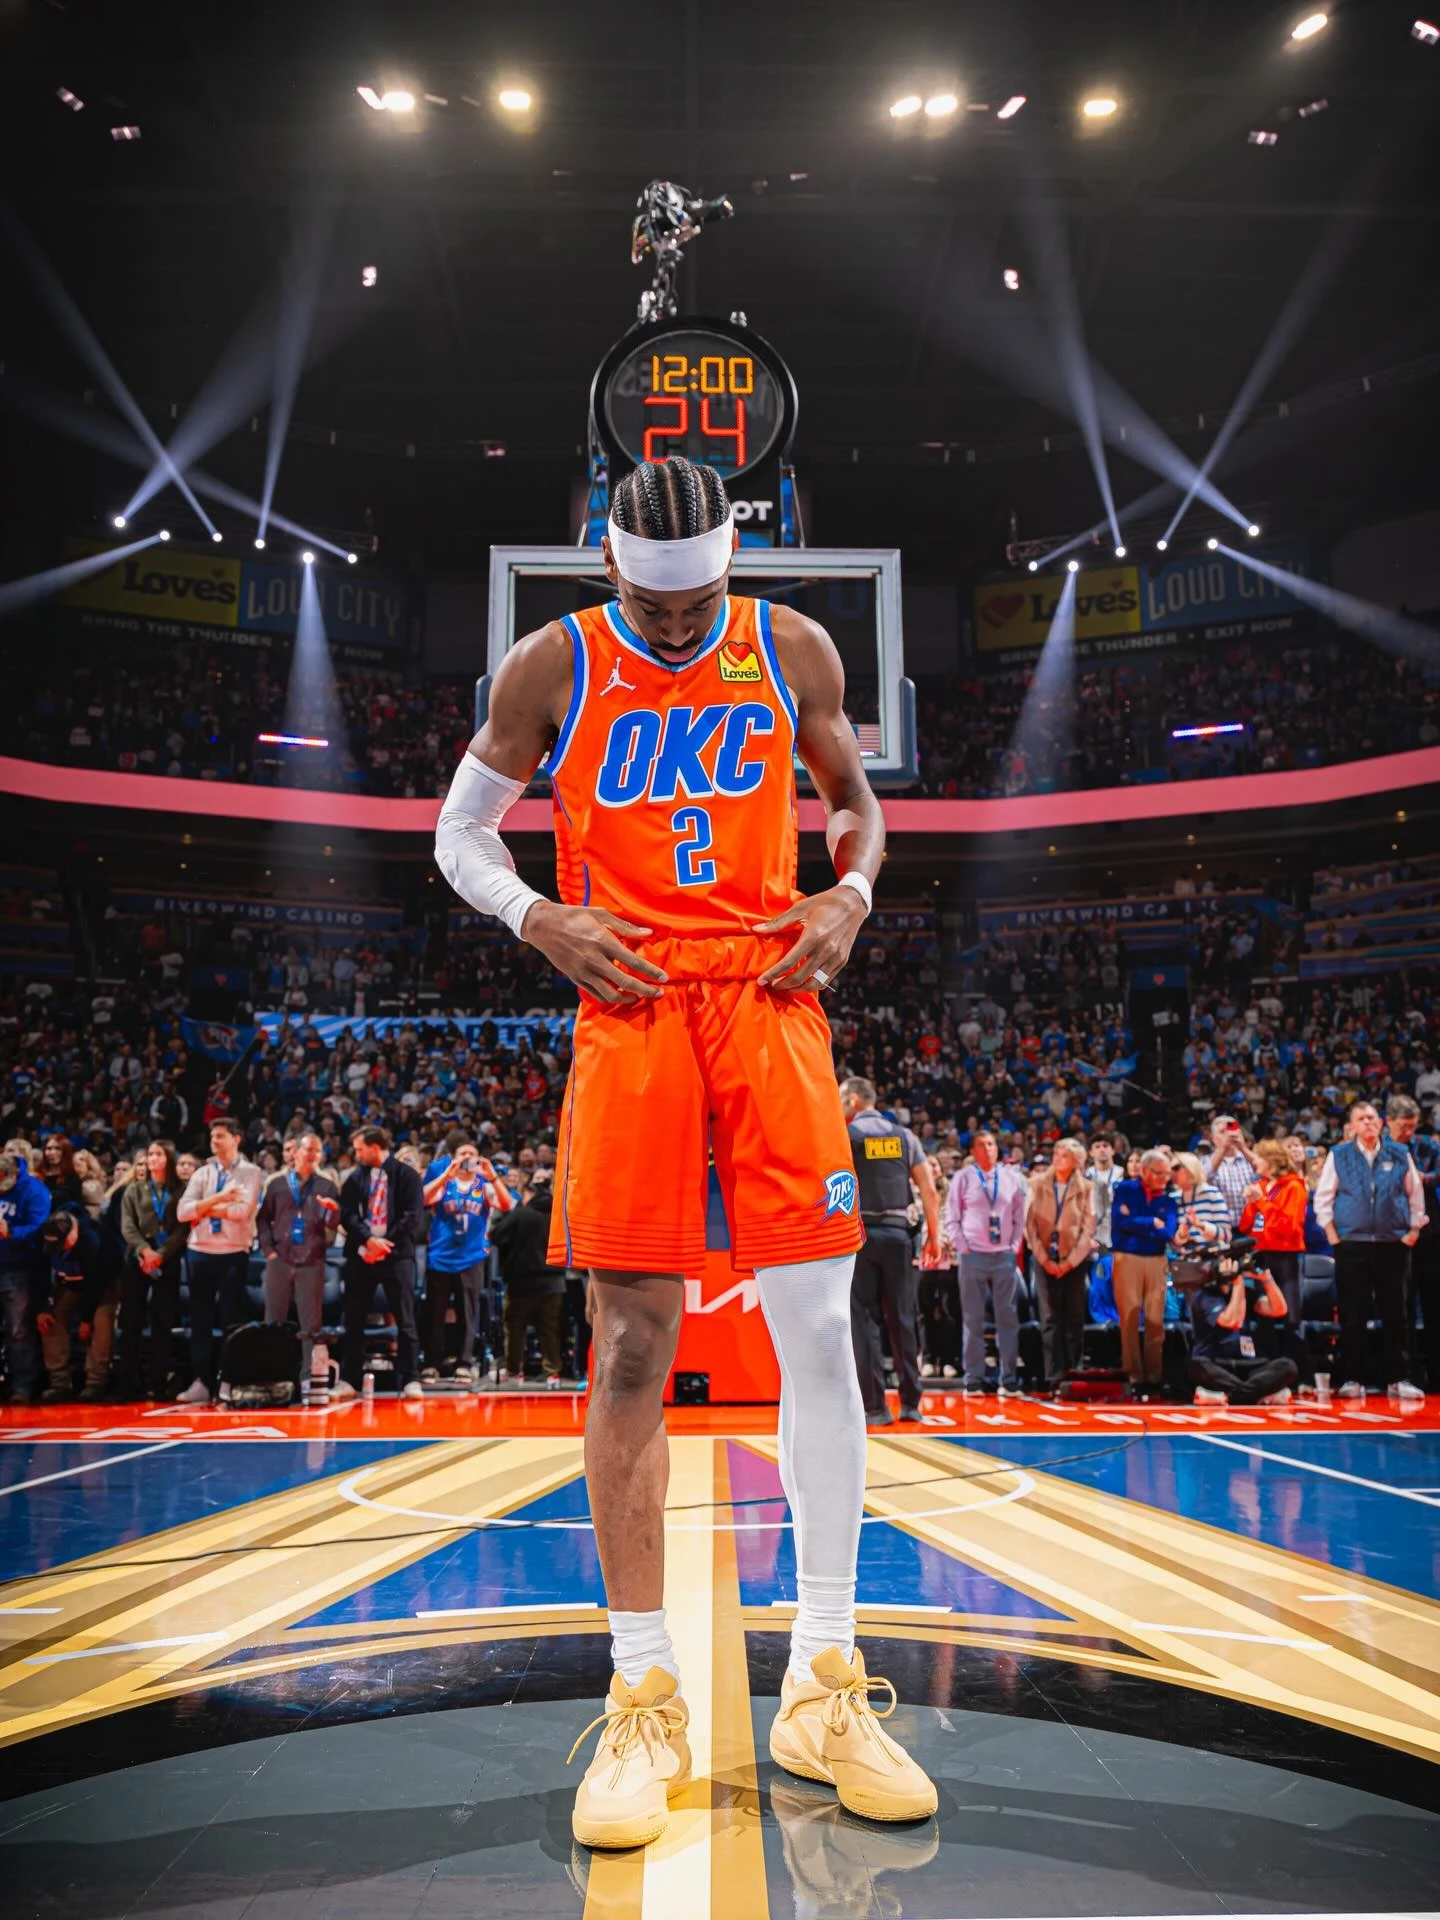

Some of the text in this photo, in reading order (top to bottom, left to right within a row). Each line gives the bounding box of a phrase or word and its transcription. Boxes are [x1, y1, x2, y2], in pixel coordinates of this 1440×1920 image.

[652, 355, 753, 394] 12:00
[643, 396, 746, 468] 24
[339, 583, 400, 637] CITY
[1148, 562, 1226, 621] LOUD
[146, 622, 182, 636] THE
[187, 626, 273, 647] THUNDER
[1095, 631, 1177, 652] THUNDER
[1204, 623, 1247, 640] EXIT
[1250, 616, 1293, 633] NOW
[595, 702, 775, 808] OKC
[671, 806, 717, 887] 2
[286, 908, 364, 925] CASINO
[868, 1139, 899, 1156] POLICE
[828, 1177, 851, 1210] OKC
[920, 1411, 1403, 1427] OKLAHOMA
